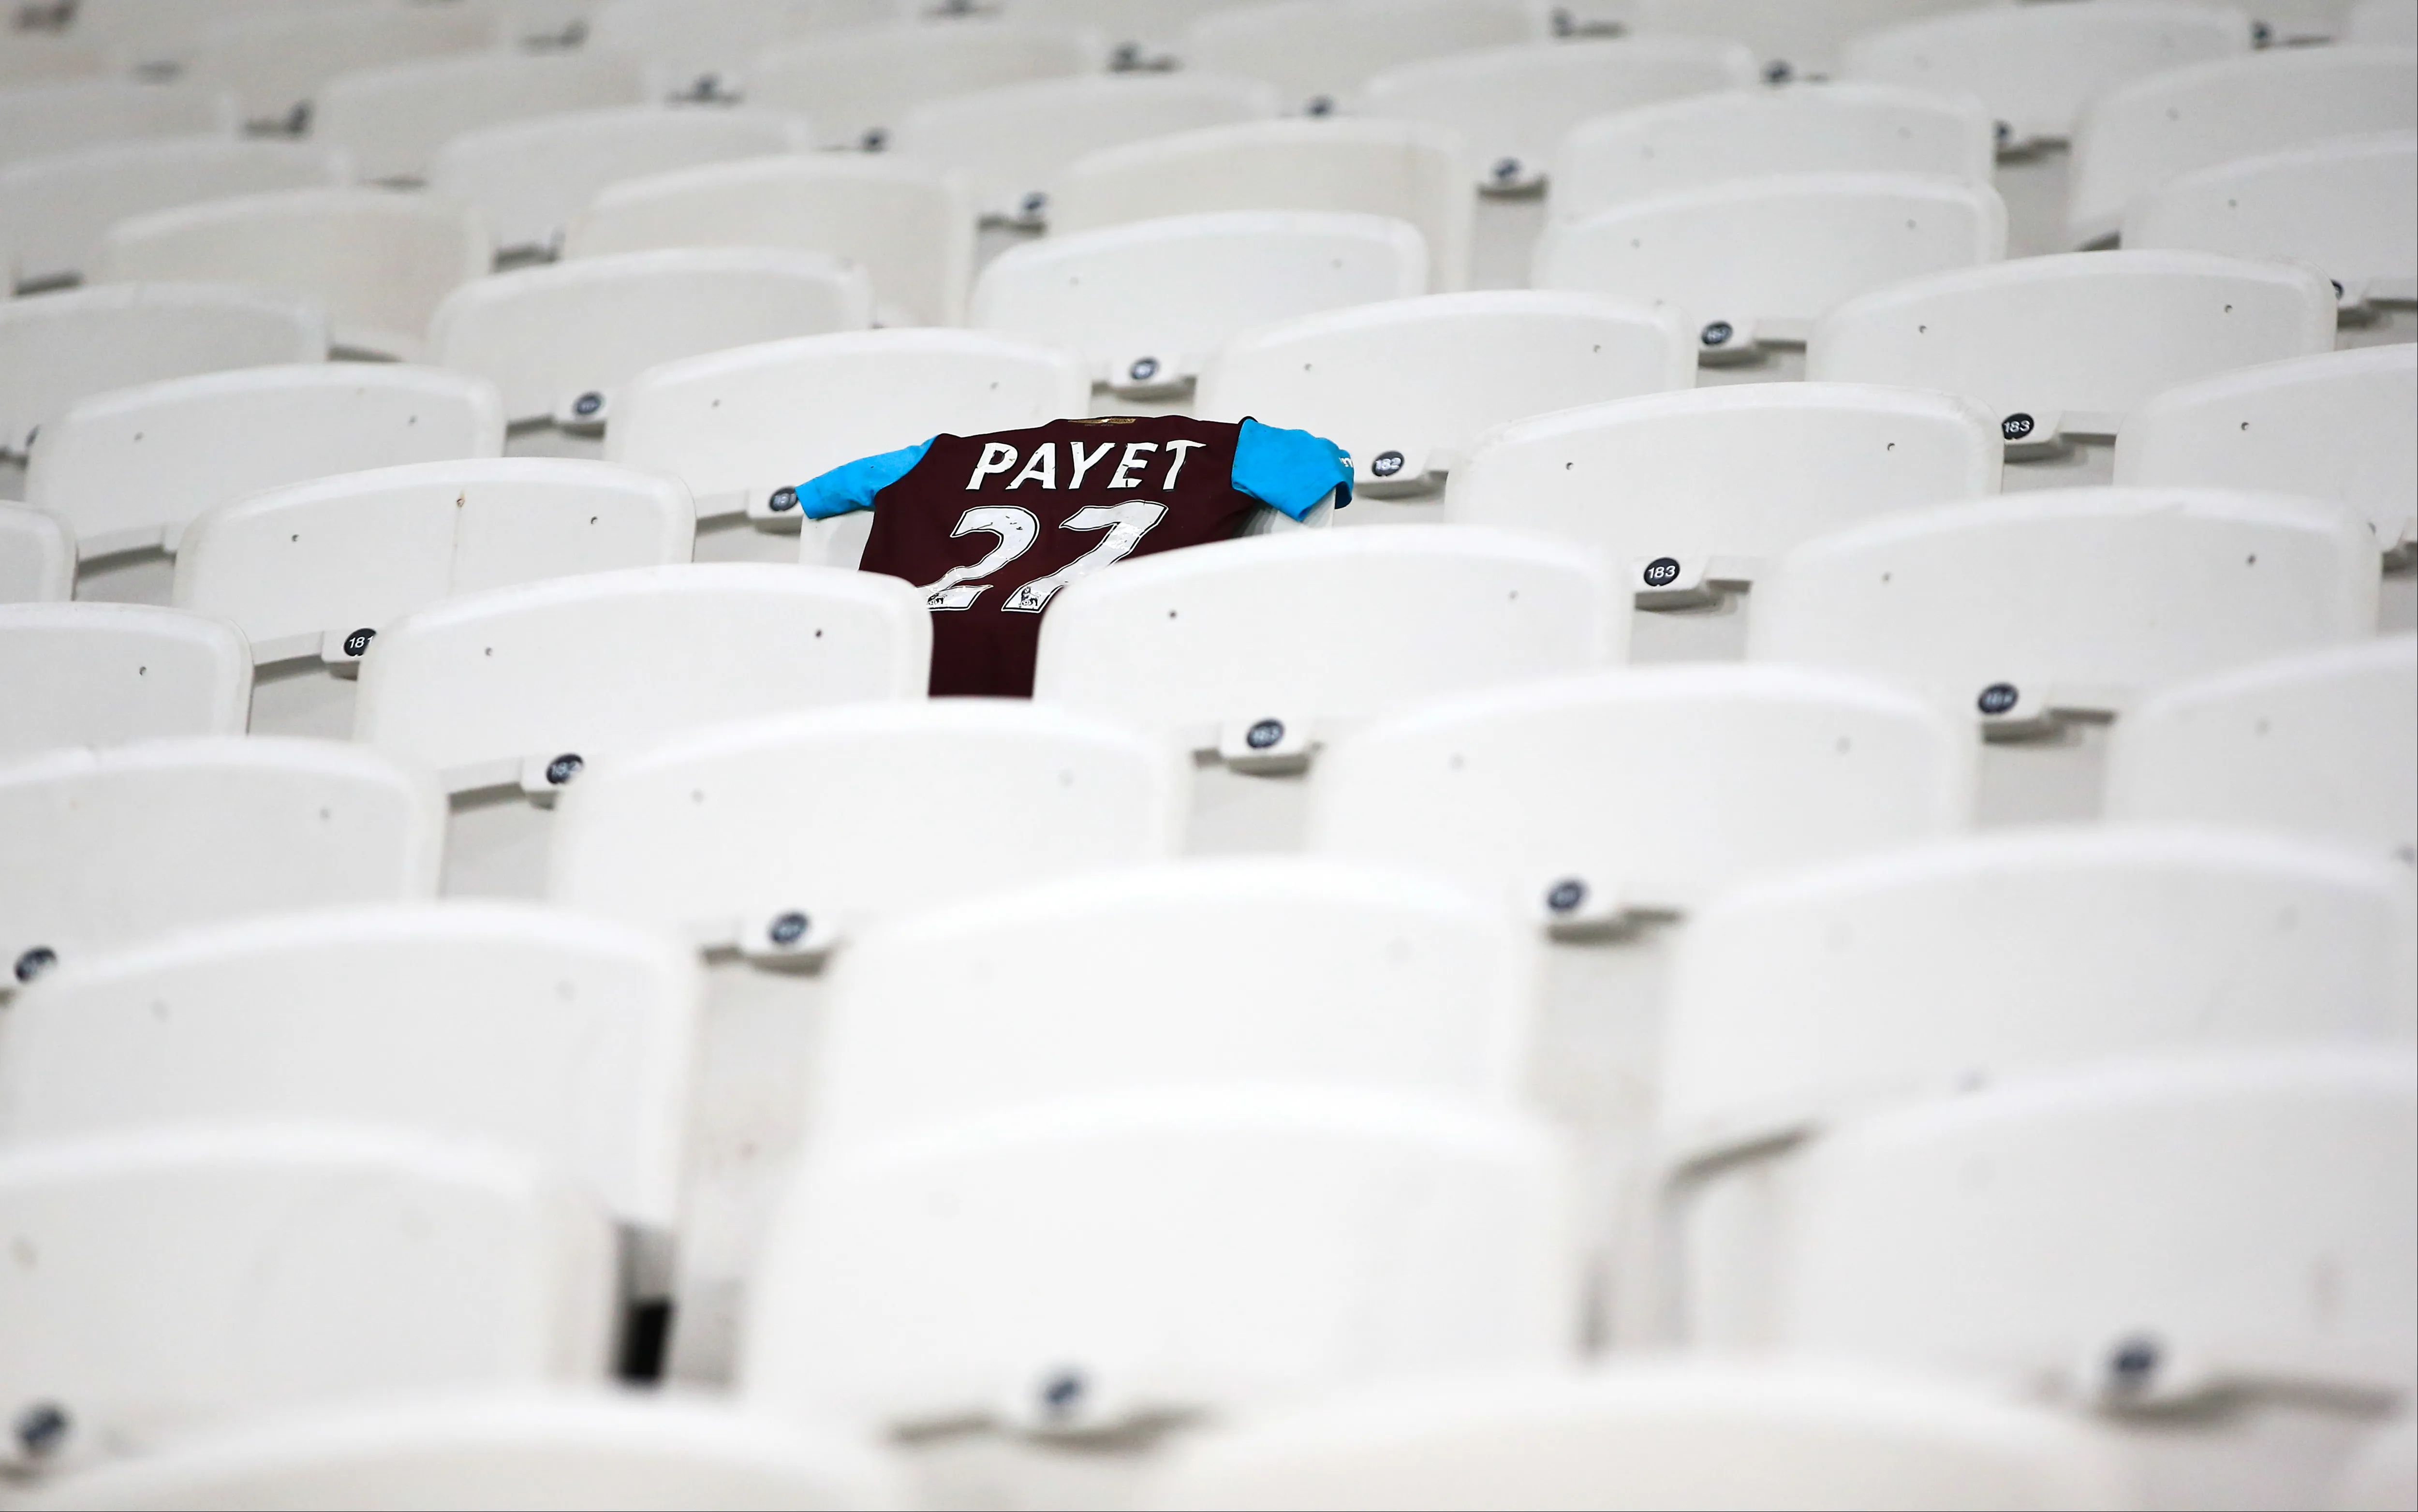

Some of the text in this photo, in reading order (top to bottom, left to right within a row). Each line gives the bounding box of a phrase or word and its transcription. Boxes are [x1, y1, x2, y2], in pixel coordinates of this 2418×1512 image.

[2004, 420, 2031, 433] 183
[965, 439, 1207, 491] PAYET
[1375, 457, 1402, 470] 182
[916, 499, 1168, 613] 27
[1648, 565, 1676, 579] 183
[349, 635, 373, 649] 181
